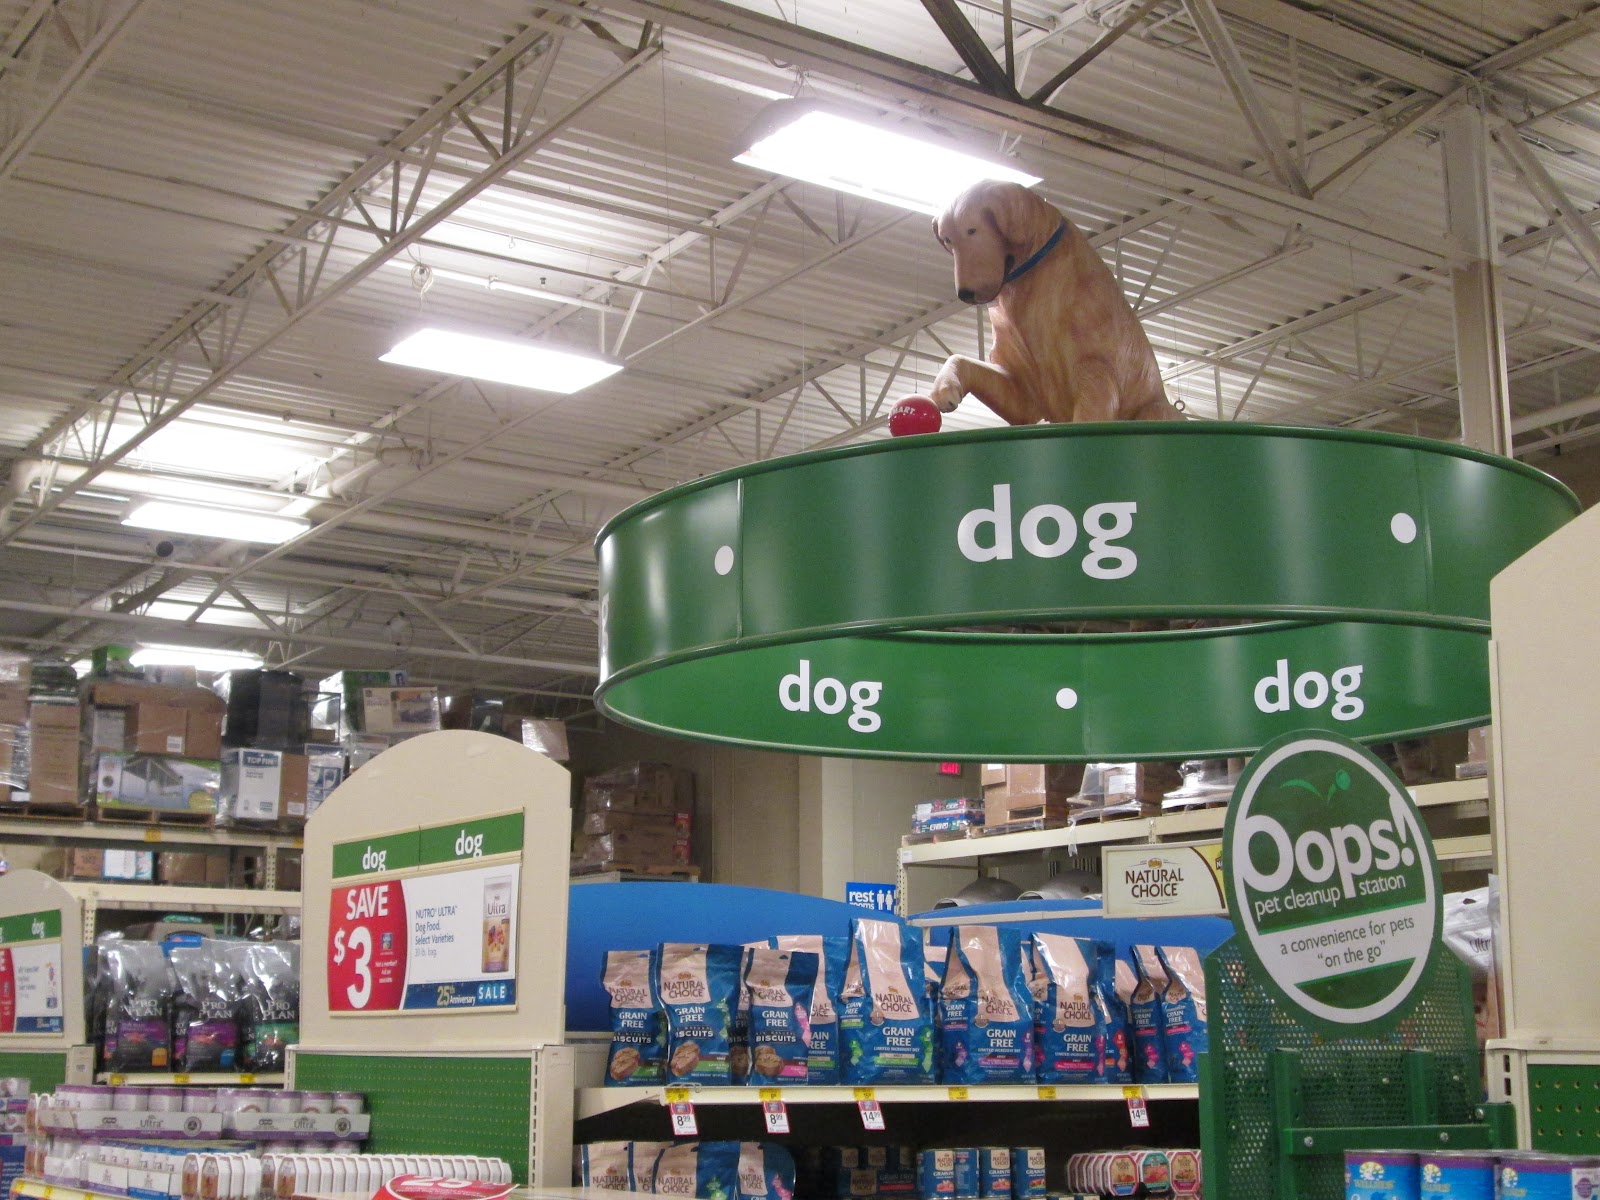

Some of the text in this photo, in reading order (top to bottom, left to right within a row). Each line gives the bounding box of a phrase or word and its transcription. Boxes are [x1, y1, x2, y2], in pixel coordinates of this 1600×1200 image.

[957, 484, 1138, 580] dog
[1253, 658, 1365, 721] dog
[778, 659, 883, 733] dog
[455, 830, 483, 858] dog
[1234, 794, 1415, 900] Oops!
[362, 845, 386, 872] dog
[1126, 868, 1184, 884] NATURAL
[849, 889, 875, 902] rest
[1131, 883, 1178, 898] CHOICE
[346, 885, 389, 921] SAVE
[1254, 874, 1406, 922] pet cleanup station
[487, 901, 506, 916] Ultra
[31, 918, 45, 939] dog
[415, 923, 426, 934] Dog
[415, 933, 455, 946] Select Varieties
[1280, 916, 1415, 956] a convenience for pets
[1469, 937, 1491, 954] Ultr
[1344, 947, 1365, 963] the
[664, 981, 705, 991] NATURAL
[449, 993, 476, 1006] Anniversary
[478, 986, 506, 1000] SALE
[668, 990, 703, 999] CHOICE
[875, 993, 914, 1005] NATURAL
[201, 1000, 228, 1011] PRO
[267, 1001, 290, 1011] PRO
[675, 1006, 706, 1016] GRAIN
[881, 1001, 912, 1013] CHOICE
[198, 1009, 233, 1019] PLAN
[263, 1010, 296, 1020] PLAN
[619, 1012, 647, 1020] GRAIN
[680, 1013, 703, 1023] FREE
[762, 1010, 789, 1019] GRAIN
[1167, 1010, 1184, 1018] GRAIN
[621, 1020, 644, 1028] FREE
[766, 1019, 788, 1028] FREE
[882, 1026, 915, 1037] GRAIN
[986, 1030, 1017, 1038] GRAIN
[756, 1035, 797, 1043] BISCUITS
[886, 1036, 911, 1046] FREE
[990, 1038, 1014, 1048] FREE
[1063, 1033, 1092, 1043] GRAIN
[809, 1041, 827, 1050] REE
[1066, 1043, 1089, 1052] FREE
[140, 1118, 163, 1129] Ultra
[294, 1119, 315, 1129] Ultra
[658, 1177, 694, 1186] NATURAL
[662, 1185, 690, 1194] CHOICE
